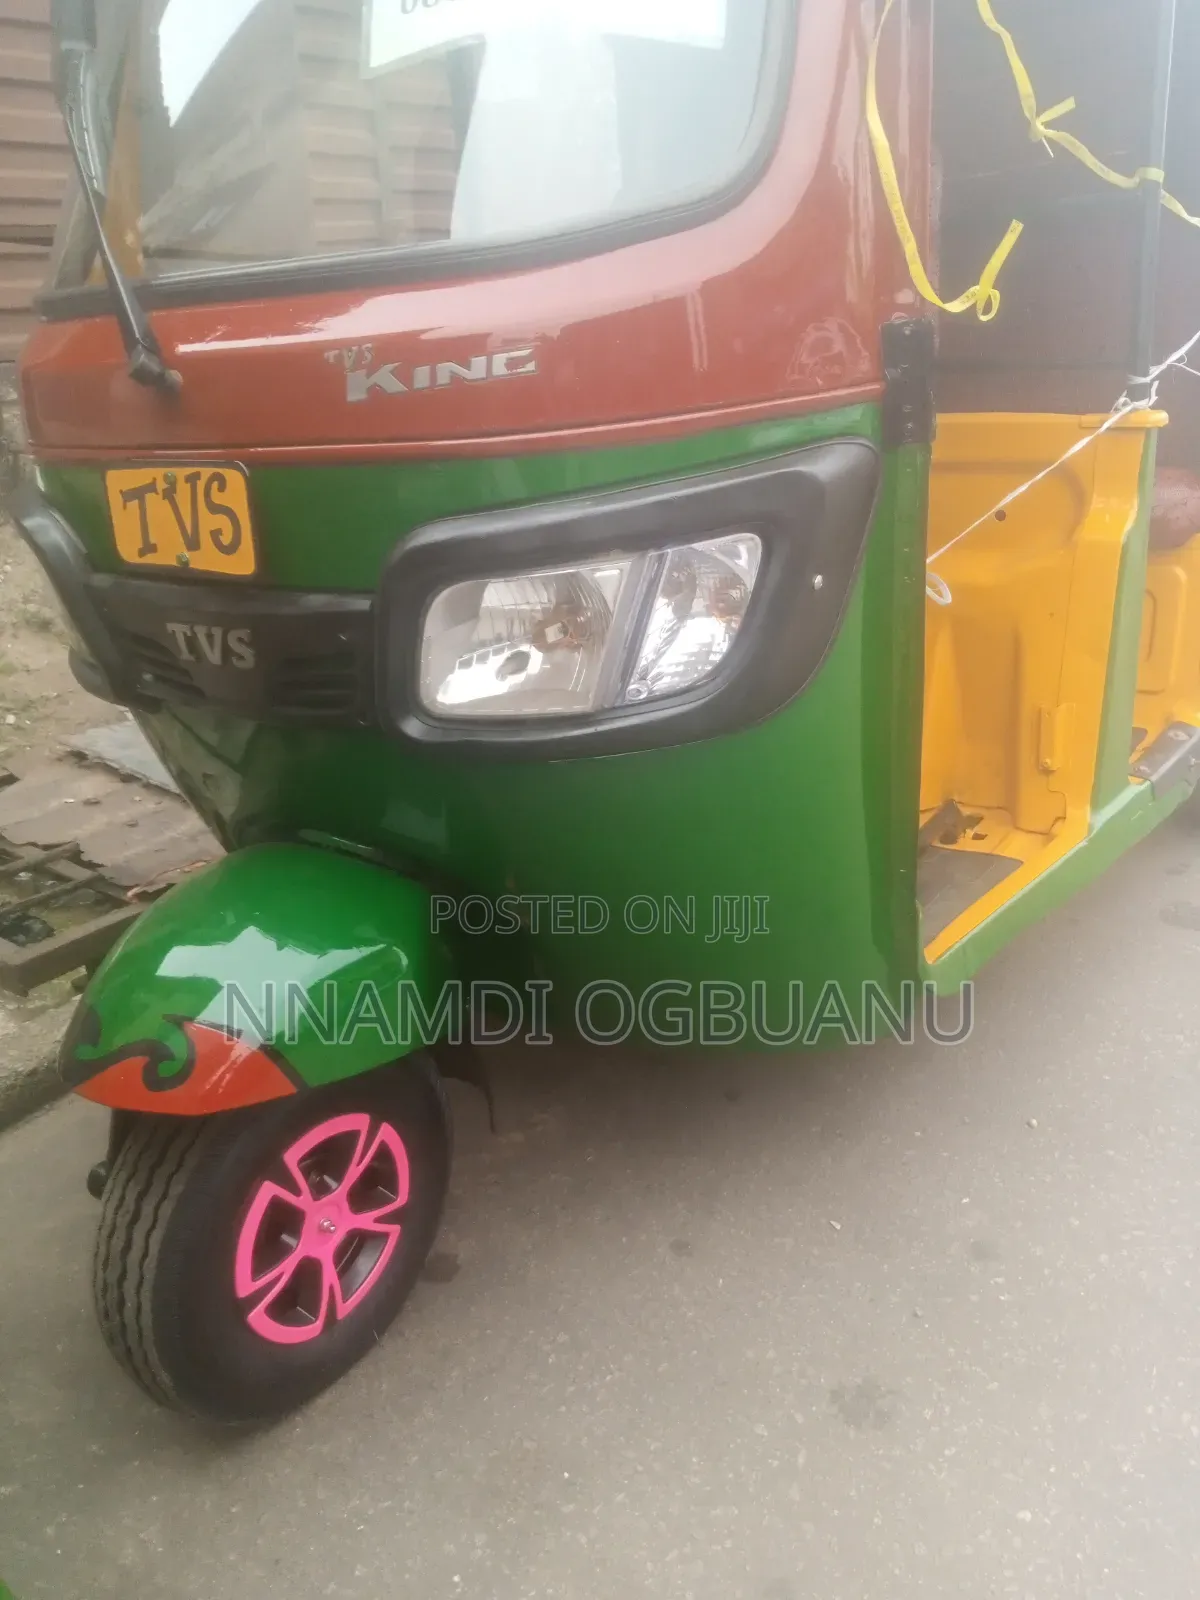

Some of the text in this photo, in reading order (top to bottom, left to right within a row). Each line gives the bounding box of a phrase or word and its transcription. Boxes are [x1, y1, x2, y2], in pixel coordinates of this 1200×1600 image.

[324, 343, 373, 371] TVS
[347, 349, 537, 402] KING
[120, 470, 242, 558] TVS
[166, 622, 255, 669] TVS
